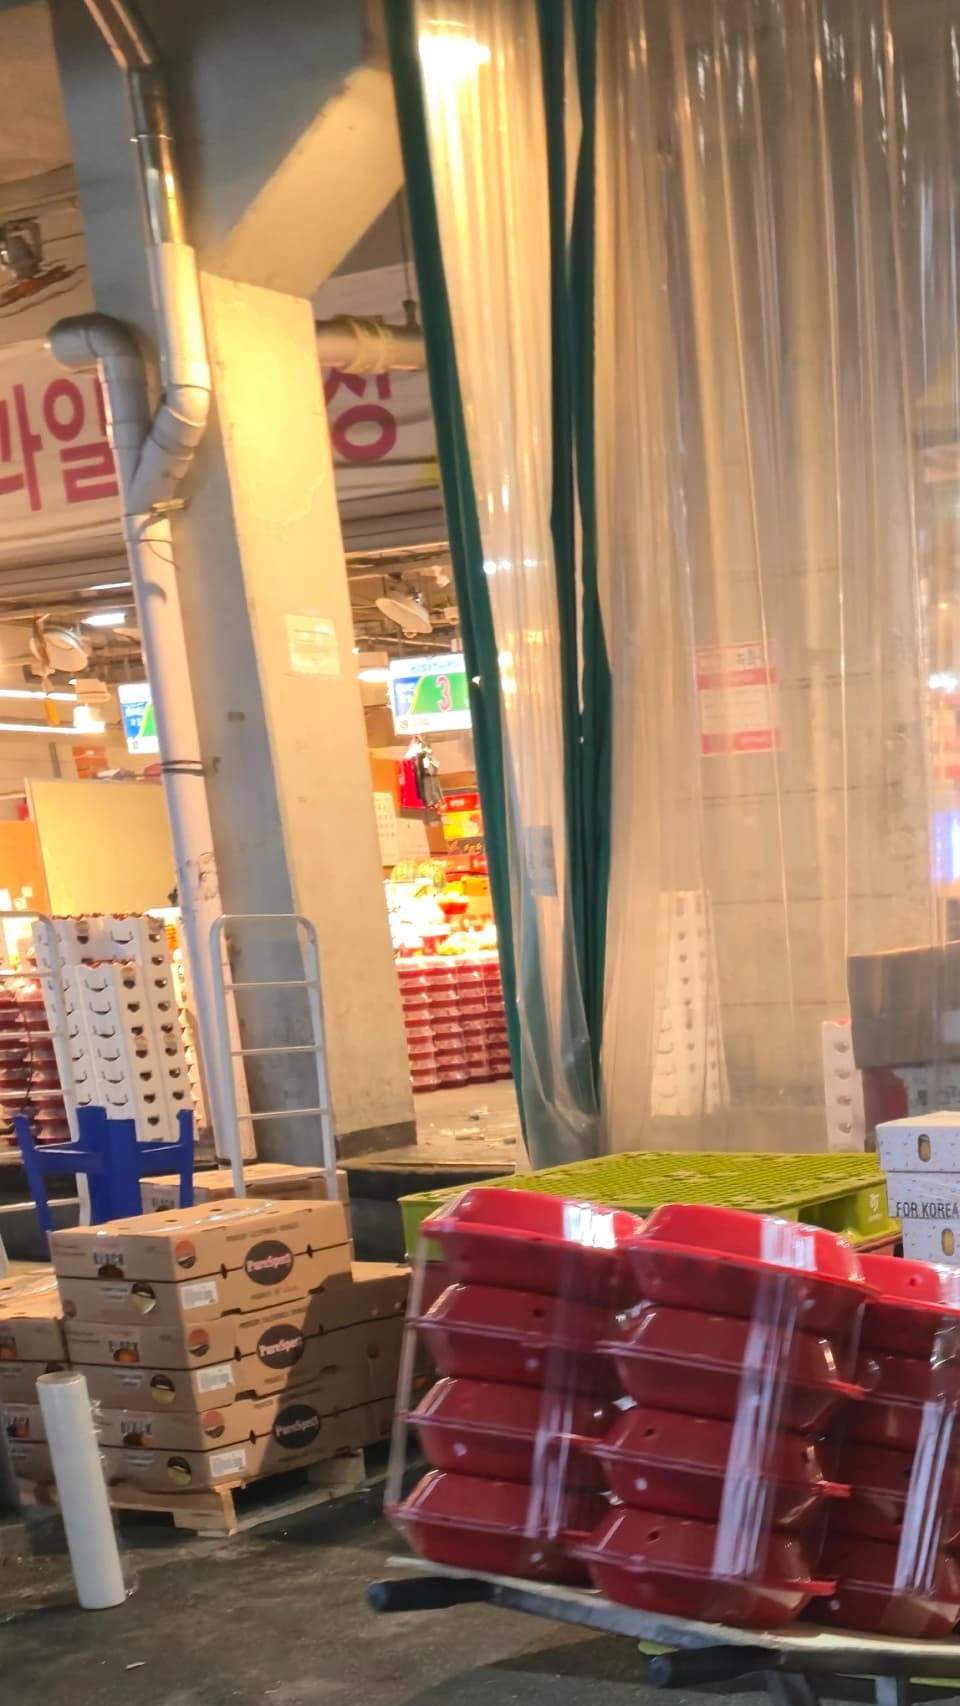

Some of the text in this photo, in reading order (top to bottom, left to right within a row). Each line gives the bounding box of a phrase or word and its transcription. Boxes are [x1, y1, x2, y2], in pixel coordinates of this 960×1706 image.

[436, 675, 452, 712] 3
[896, 1201, 919, 1217] FOR
[921, 1202, 960, 1219] KOREA
